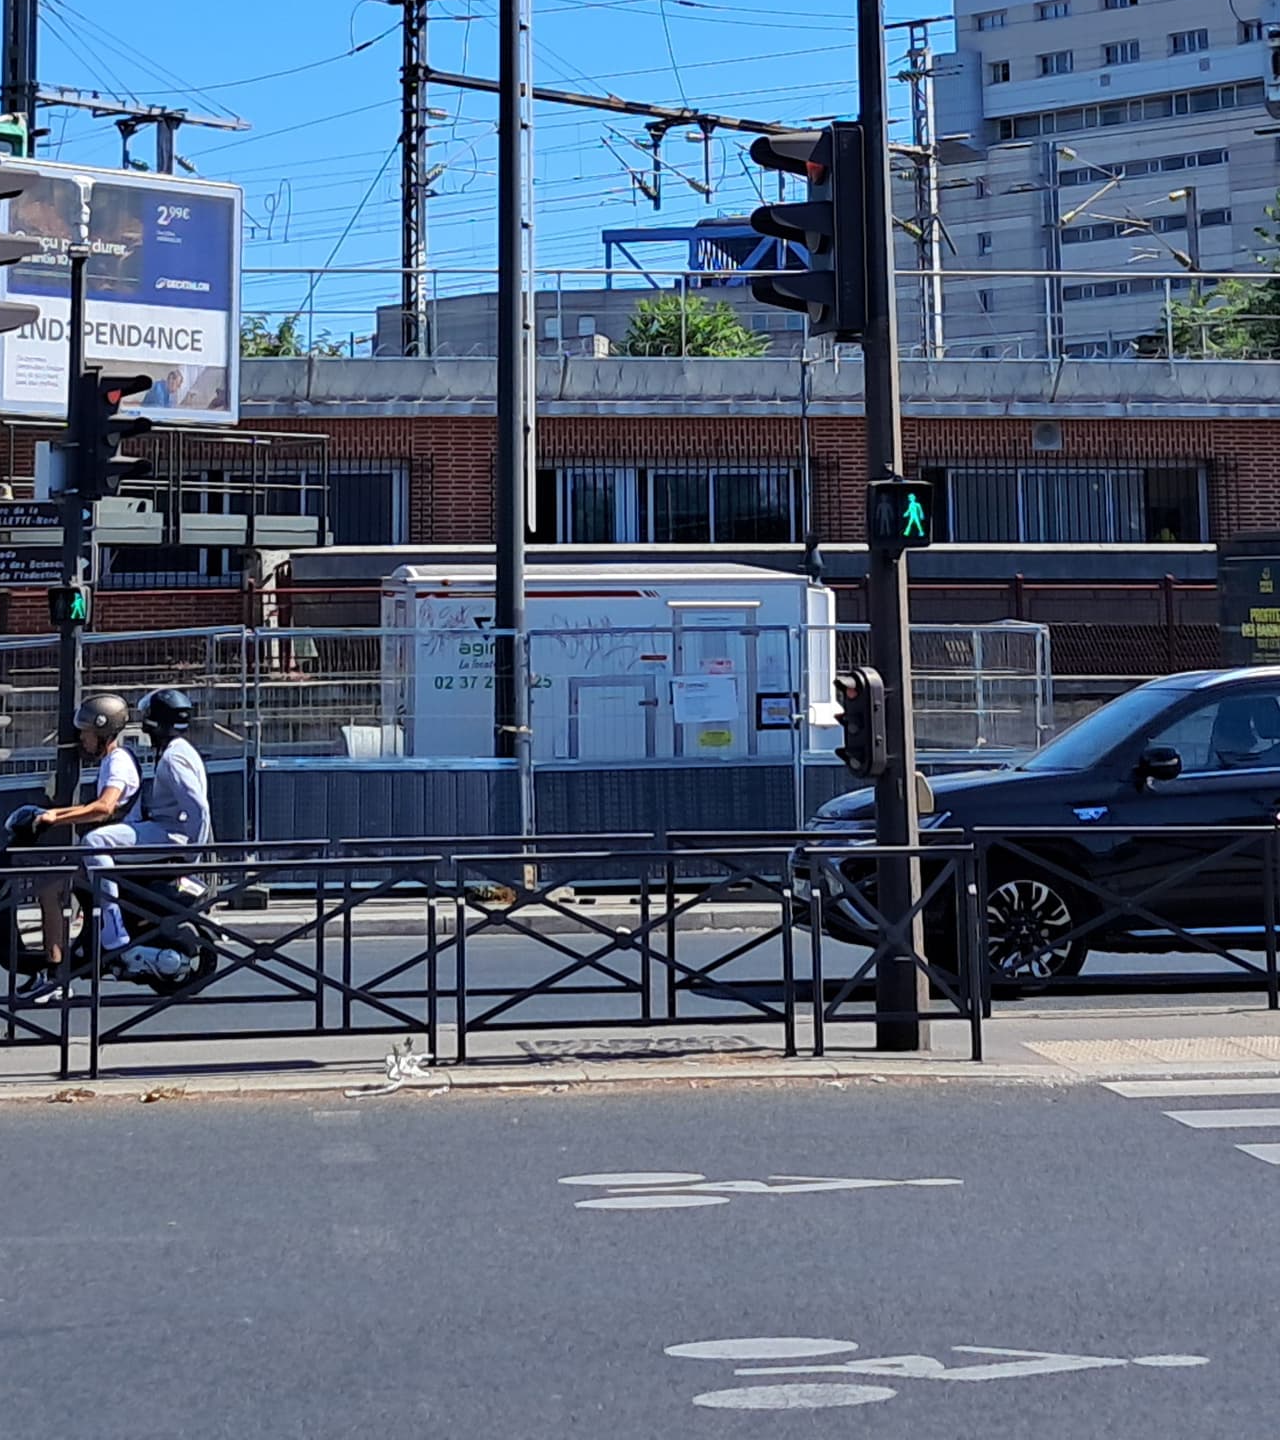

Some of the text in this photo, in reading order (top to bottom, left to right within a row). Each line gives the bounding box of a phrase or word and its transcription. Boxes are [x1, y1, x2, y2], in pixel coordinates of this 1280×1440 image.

[17, 317, 203, 352] 1NDPEND4NCE
[14, 506, 25, 515] de
[434, 675, 454, 690] 02
[460, 675, 478, 689] 37
[484, 675, 495, 689] 2
